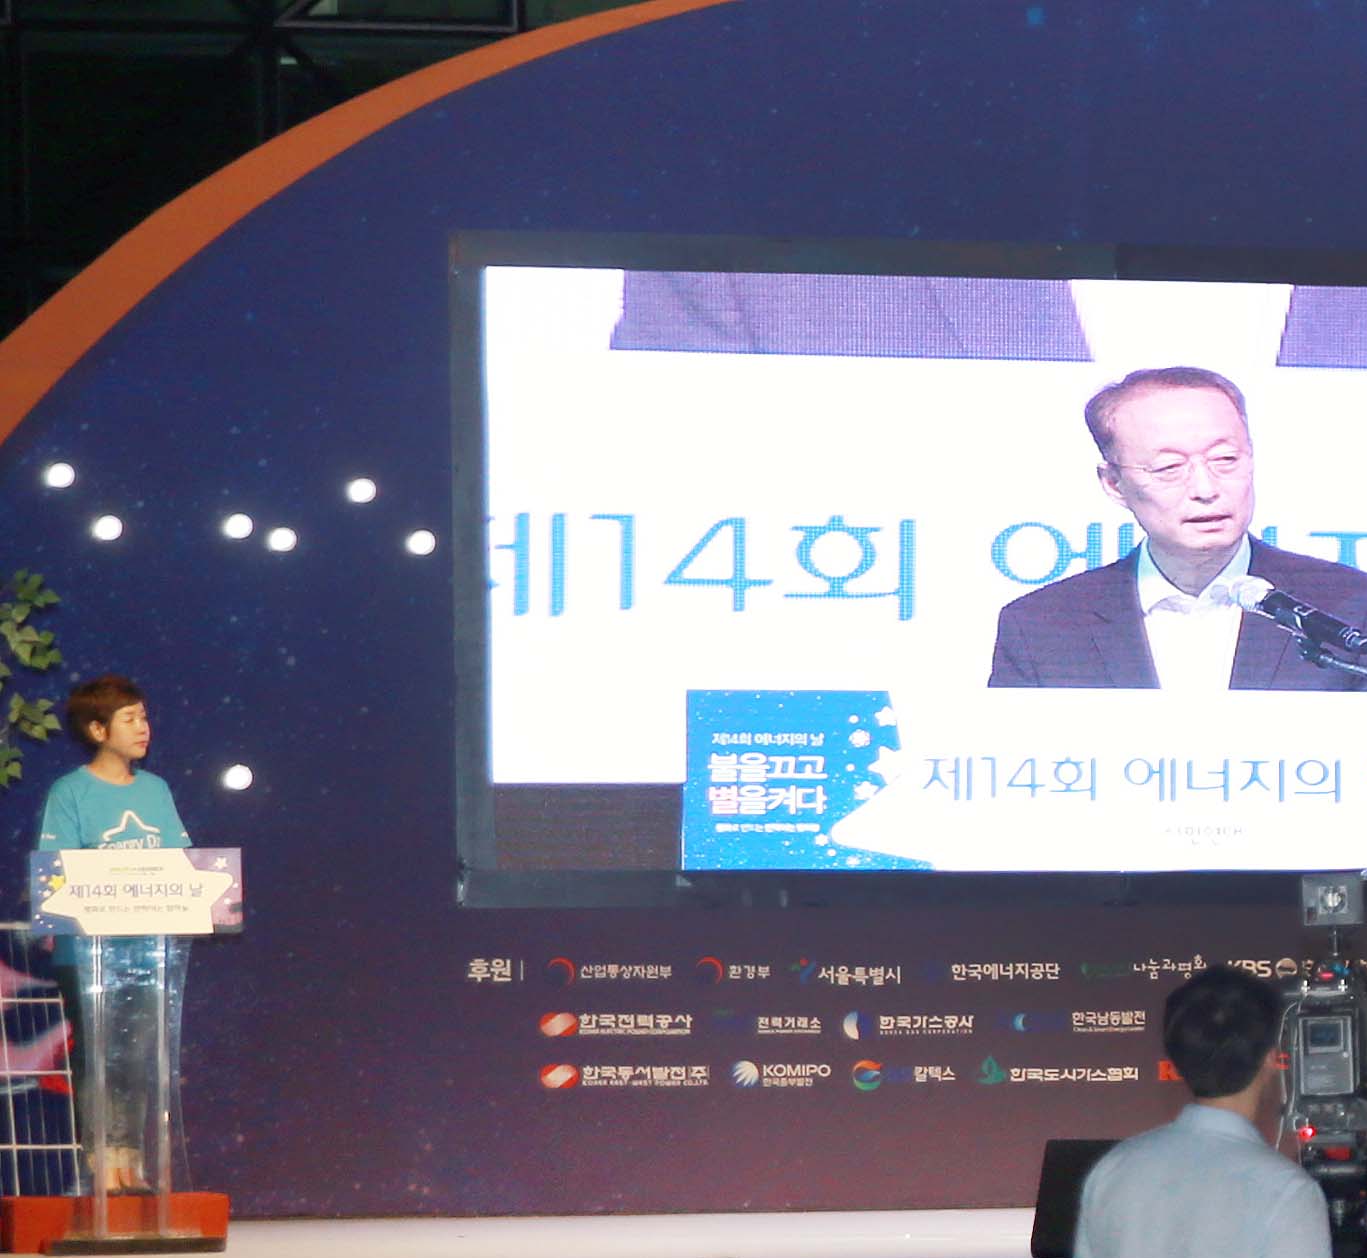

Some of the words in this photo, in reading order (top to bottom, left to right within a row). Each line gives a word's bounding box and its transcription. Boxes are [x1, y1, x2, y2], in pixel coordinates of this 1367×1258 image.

[922, 757, 1096, 801] 제14회
[1124, 757, 1341, 803] 에너지의
[122, 882, 183, 898] 에너지의
[467, 957, 512, 982] 후원
[580, 964, 673, 980] 산업통상자원부
[728, 964, 771, 980] 환경부
[818, 965, 901, 986] 서울특별시
[951, 962, 1060, 981] 한국에너지공단
[579, 1013, 693, 1029] 한국전력공사
[880, 1015, 974, 1029] 한국가스공사
[763, 1064, 831, 1077] KOMIPO
